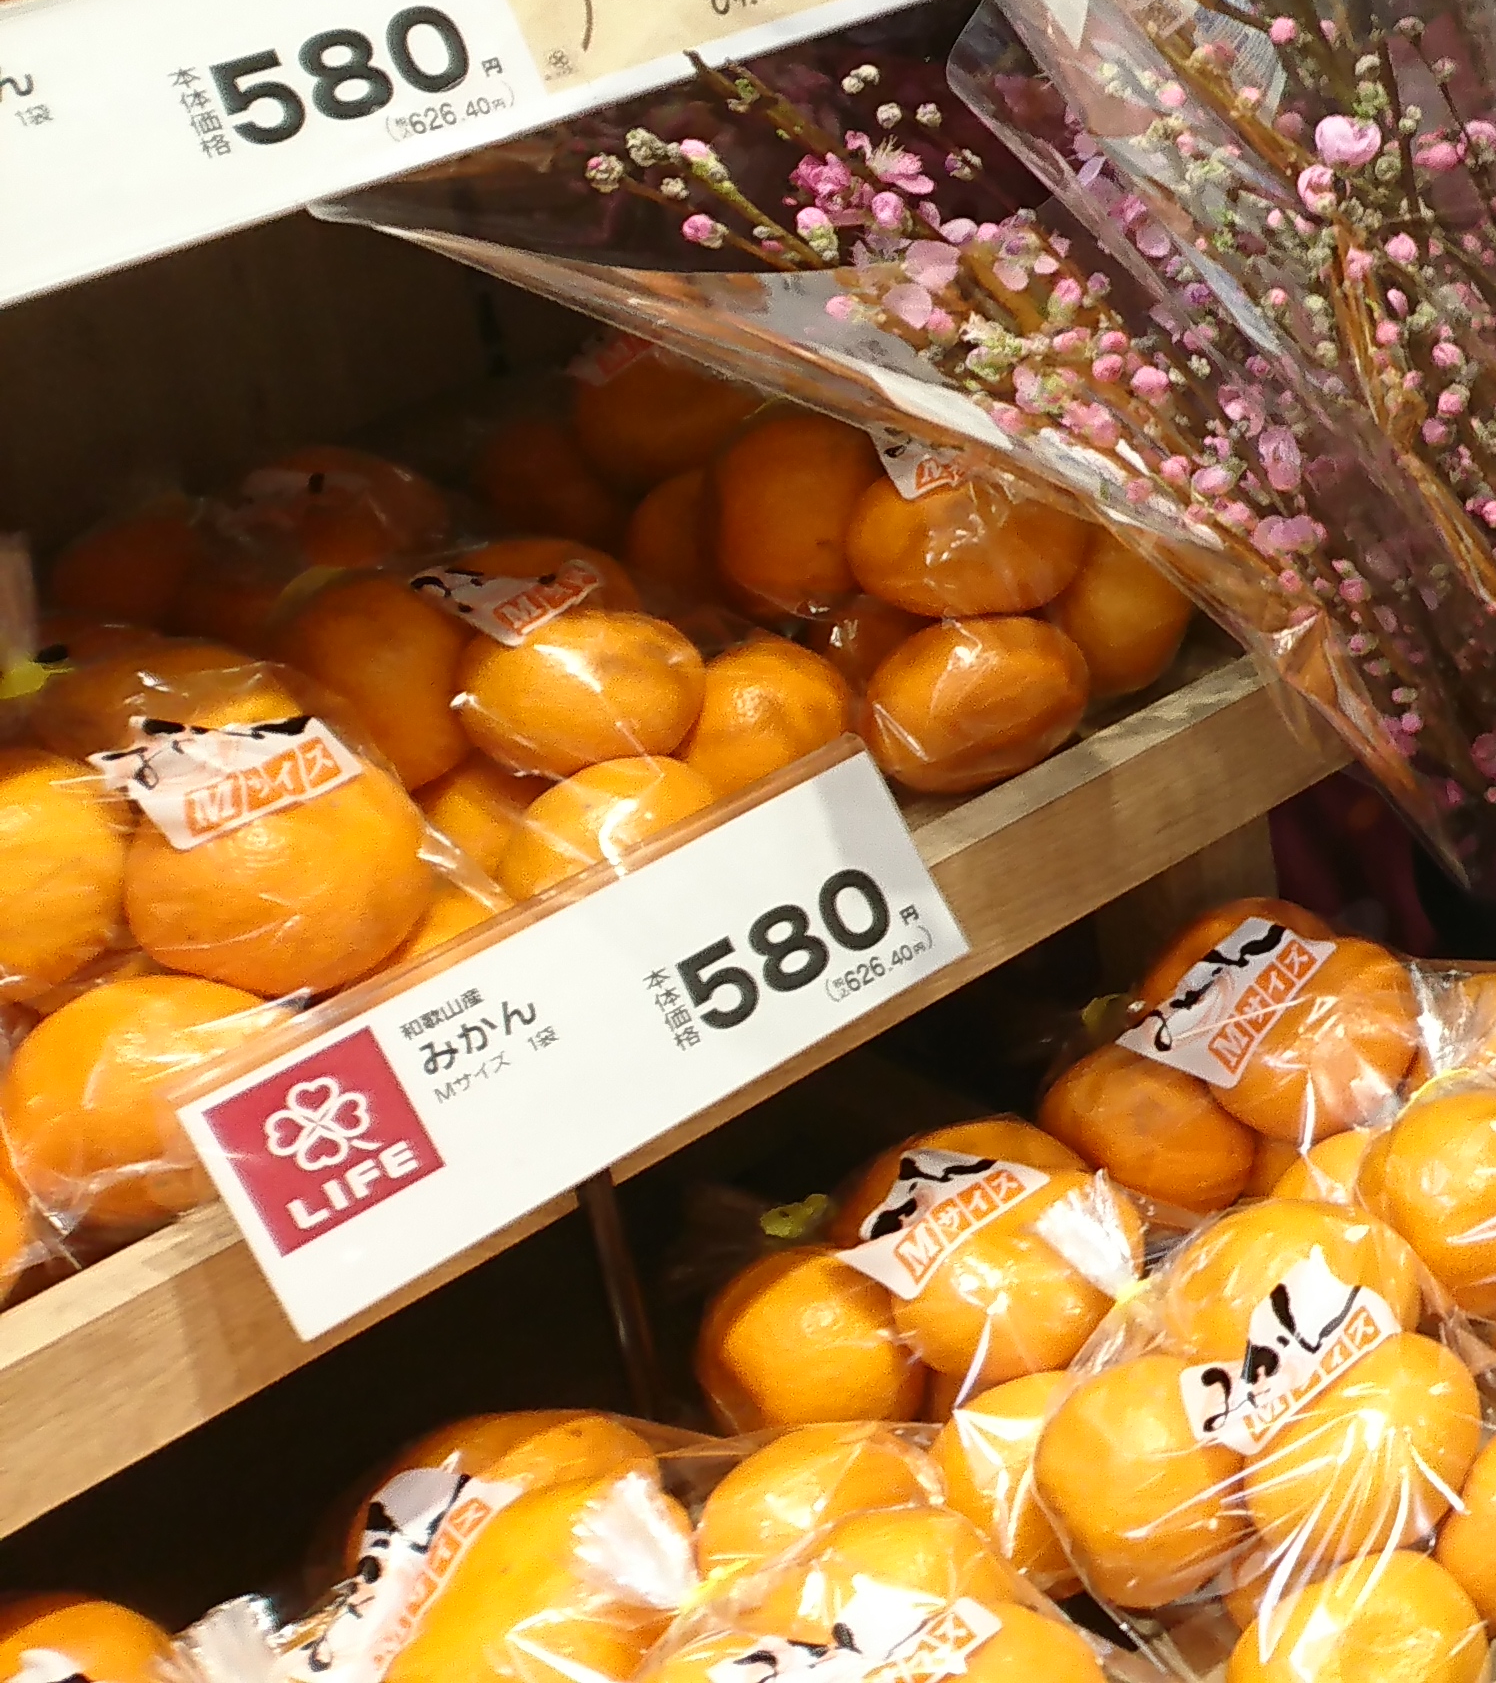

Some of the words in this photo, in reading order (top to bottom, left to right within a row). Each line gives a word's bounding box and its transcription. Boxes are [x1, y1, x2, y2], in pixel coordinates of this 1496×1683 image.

[168, 65, 233, 160] 本体価格
[208, 5, 470, 146] 580
[674, 868, 891, 1030] 580
[399, 986, 484, 1042] 和歌山産
[418, 999, 538, 1076] みかん
[641, 966, 702, 1052] 本体価格
[432, 1049, 511, 1105] Mサイズ
[285, 1139, 421, 1230] LIFE
